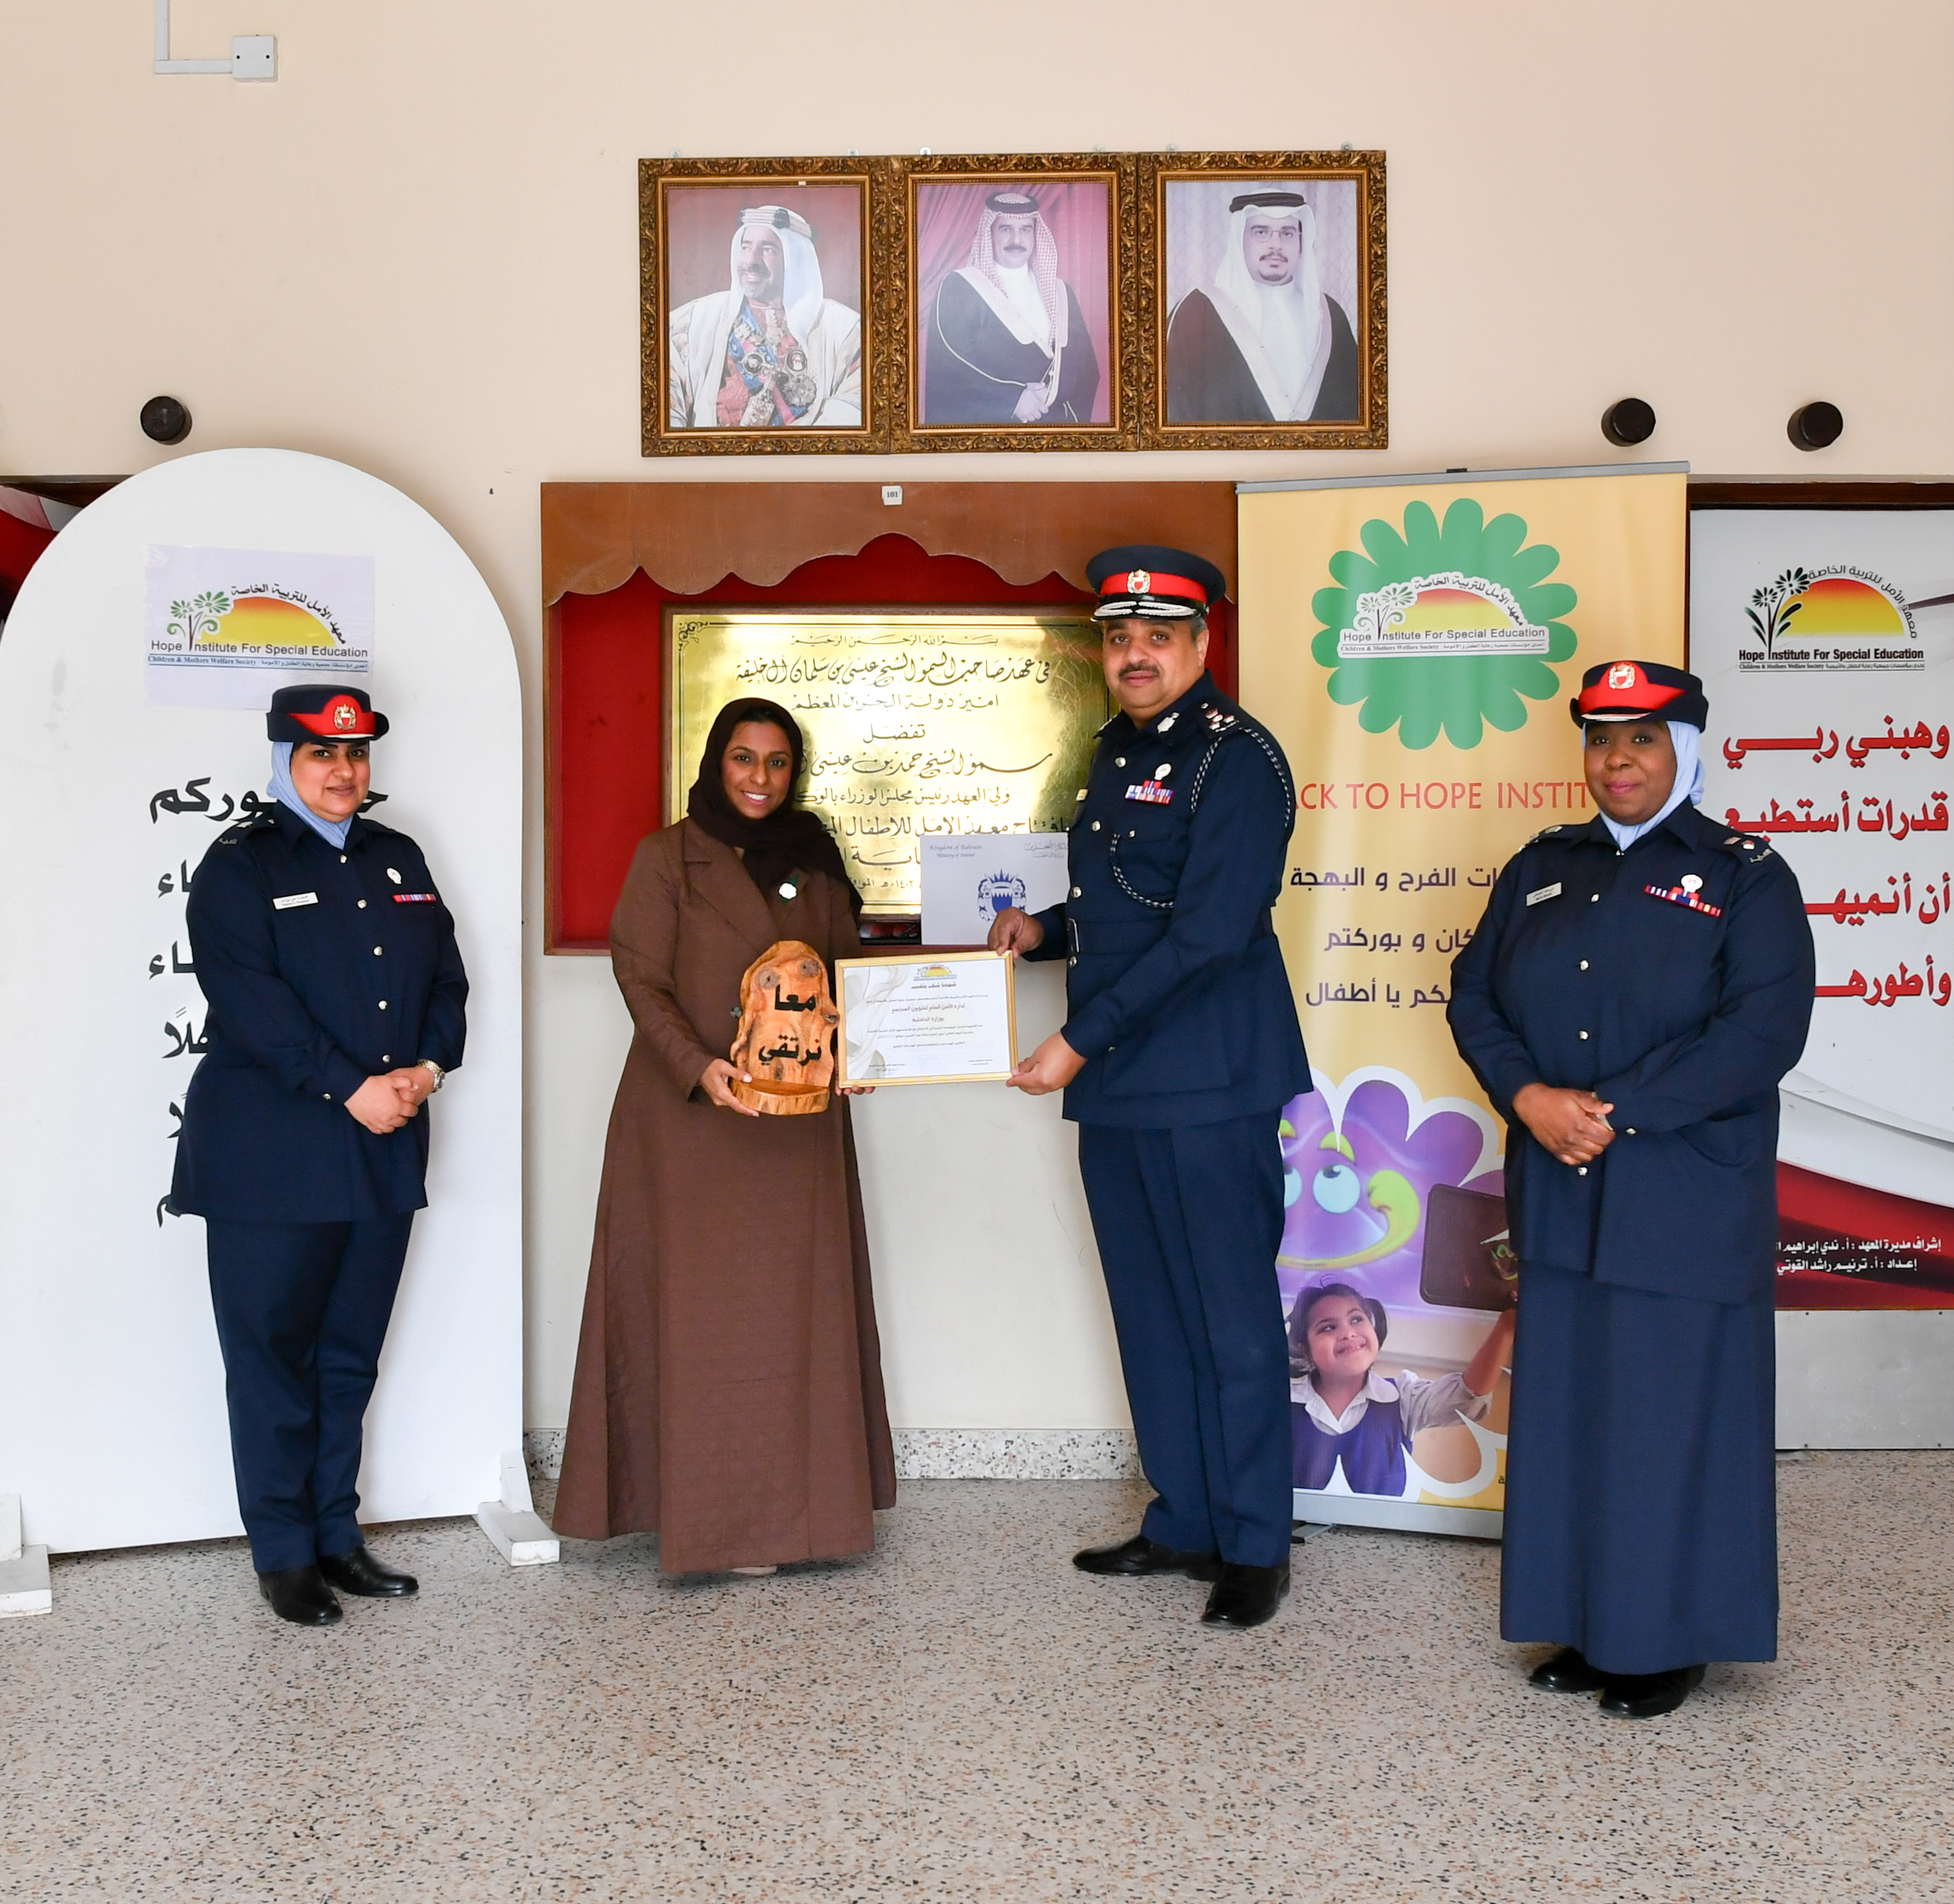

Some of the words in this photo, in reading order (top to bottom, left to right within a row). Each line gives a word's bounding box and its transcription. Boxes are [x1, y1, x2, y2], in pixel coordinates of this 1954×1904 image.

[1414, 576, 1450, 589] الخاصة
[1808, 565, 1846, 580] الخاصة
[1849, 566, 1882, 584] للتربية
[231, 583, 268, 596] الخاصة
[271, 583, 308, 603] للتربية
[1452, 575, 1486, 591] للتربية
[1485, 587, 1510, 605] الأمل
[1881, 583, 1906, 604] الأمل
[307, 600, 332, 619] الأمل
[1507, 605, 1523, 626] معهد
[1901, 604, 1918, 639] معهد
[329, 621, 346, 645] معهد
[1343, 632, 1371, 643] Hope
[1425, 630, 1444, 640] For
[1447, 629, 1486, 640] Special
[1491, 627, 1545, 638] Education
[151, 640, 182, 653] Hope
[242, 643, 262, 653] For
[265, 644, 308, 656] Special
[312, 646, 368, 657] Education
[1739, 650, 1764, 663] Hope
[1814, 649, 1830, 660] For
[1833, 648, 1871, 661] Special
[1874, 648, 1924, 659] Education
[863, 724, 926, 744] تفضل
[1845, 714, 1950, 769] وهبني
[1722, 726, 1839, 769] ربي
[1295, 782, 1338, 810] CK
[1346, 782, 1390, 810] TO
[1400, 782, 1482, 810] HOPE
[1497, 781, 1588, 809] INSTIT
[1857, 791, 1949, 840] قدرات
[1290, 867, 1365, 892] البهجة
[1375, 871, 1388, 891] و
[1398, 867, 1456, 892] الفرح
[1804, 872, 1912, 926] أنميه
[1919, 872, 1950, 924] أن
[1324, 928, 1402, 953] بوركتم
[1412, 932, 1426, 952] و
[1815, 955, 1952, 1007] وأطوره
[1305, 977, 1376, 1007] أطفال
[1386, 983, 1400, 1008] يا
[758, 1034, 821, 1067] نرتقي
[1782, 1240, 1819, 1254] إبراهيم
[1858, 1239, 1882, 1253] المعهد
[1883, 1238, 1911, 1253] مديرة
[1913, 1235, 1942, 1253] إشراف
[1810, 1257, 1832, 1273] راشد
[1832, 1257, 1868, 1273] ترنيم
[1887, 1258, 1918, 1272] إعداد
